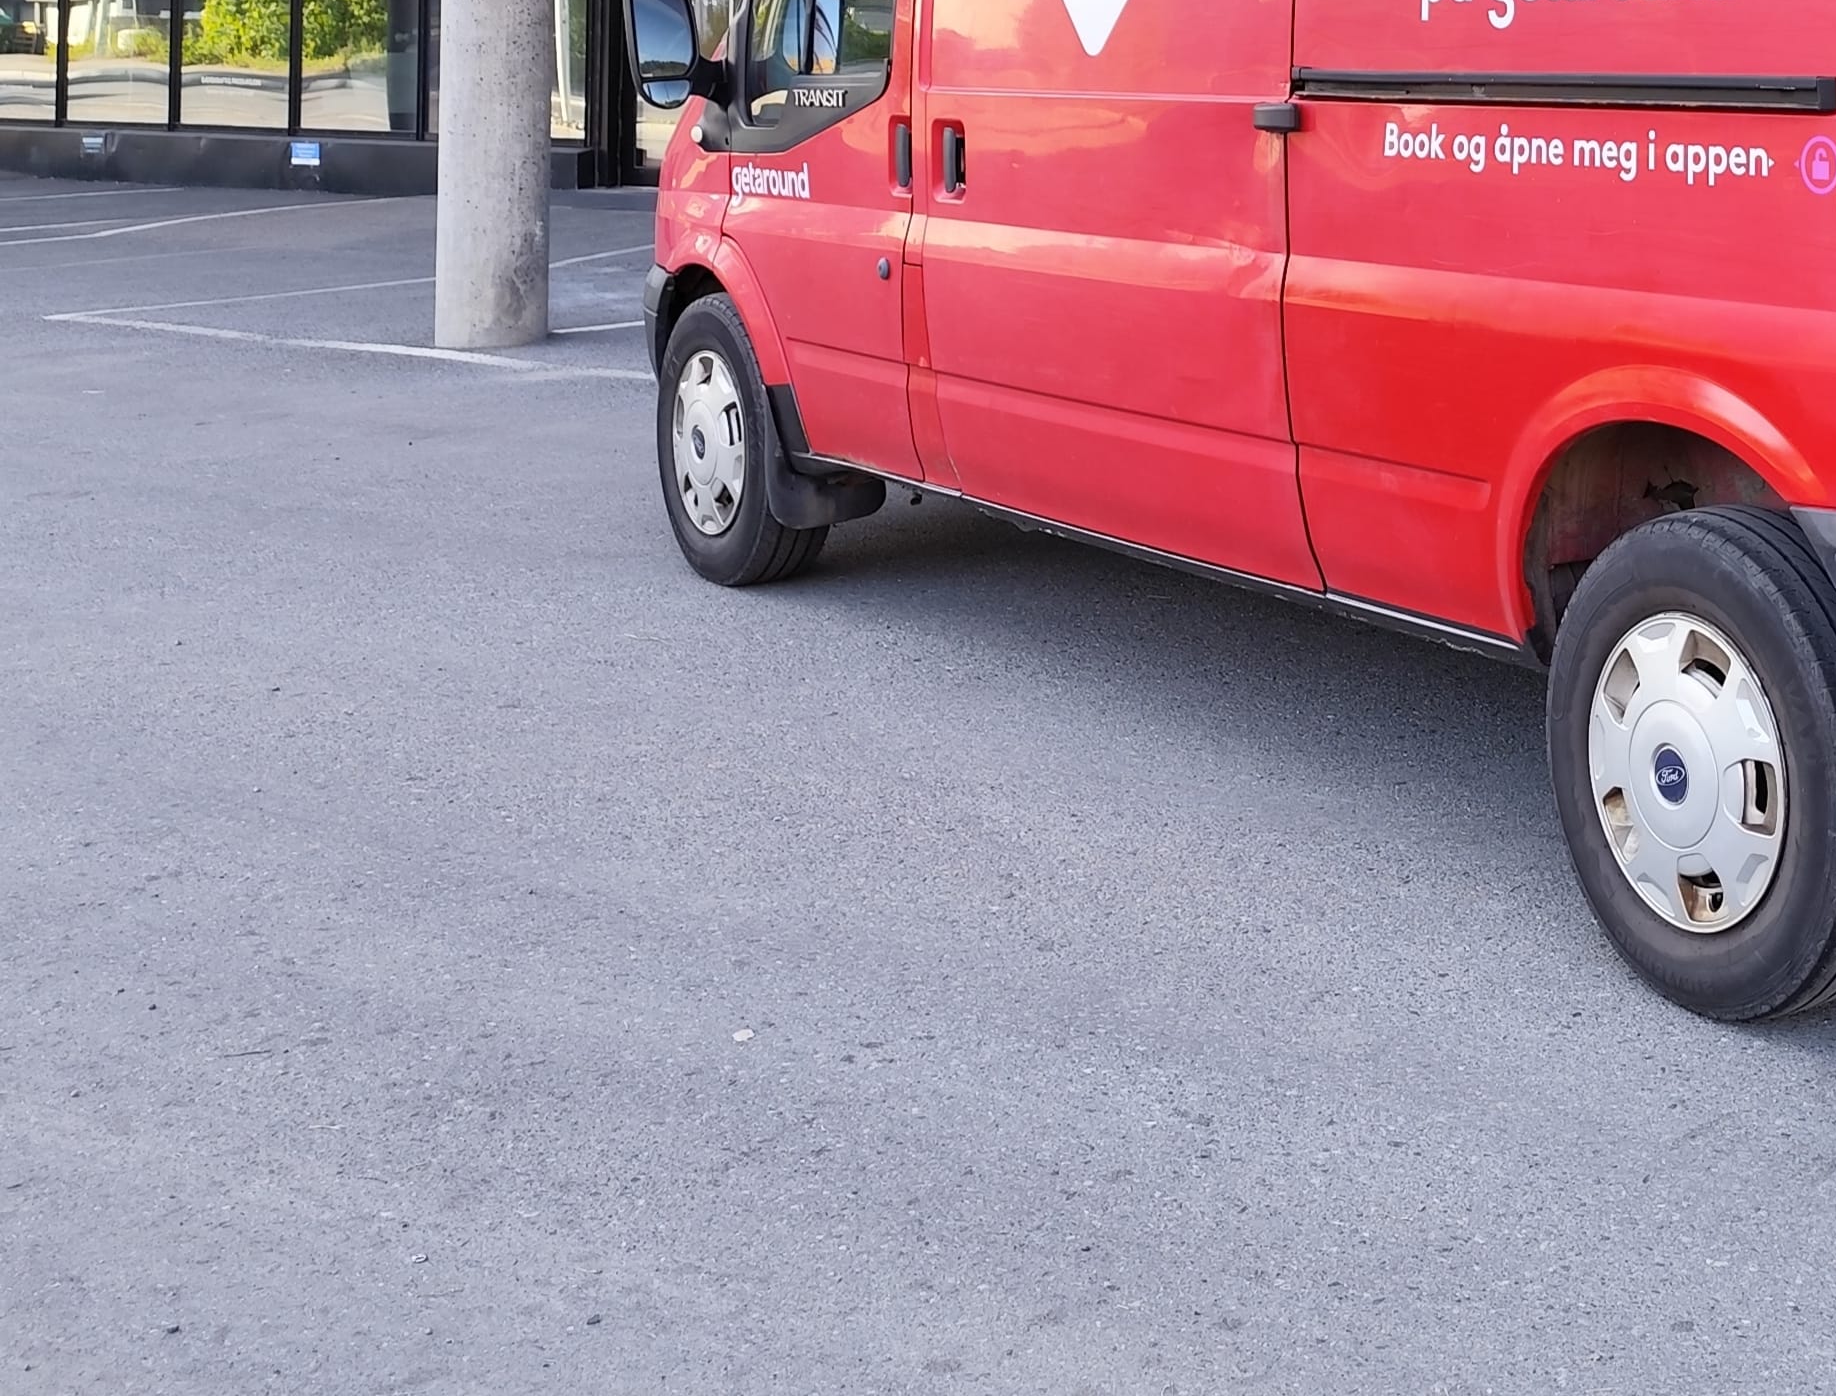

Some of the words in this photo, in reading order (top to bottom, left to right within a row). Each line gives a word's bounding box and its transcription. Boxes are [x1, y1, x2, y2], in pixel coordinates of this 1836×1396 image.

[793, 89, 847, 107] TRANSIT
[1383, 122, 1445, 160] Book
[1453, 133, 1487, 173] og
[1494, 124, 1564, 174] åpne
[1573, 137, 1638, 182] meg
[1648, 131, 1656, 170] i
[1665, 140, 1769, 186] appen
[732, 162, 810, 206] getaround
[1660, 768, 1680, 784] Ford
